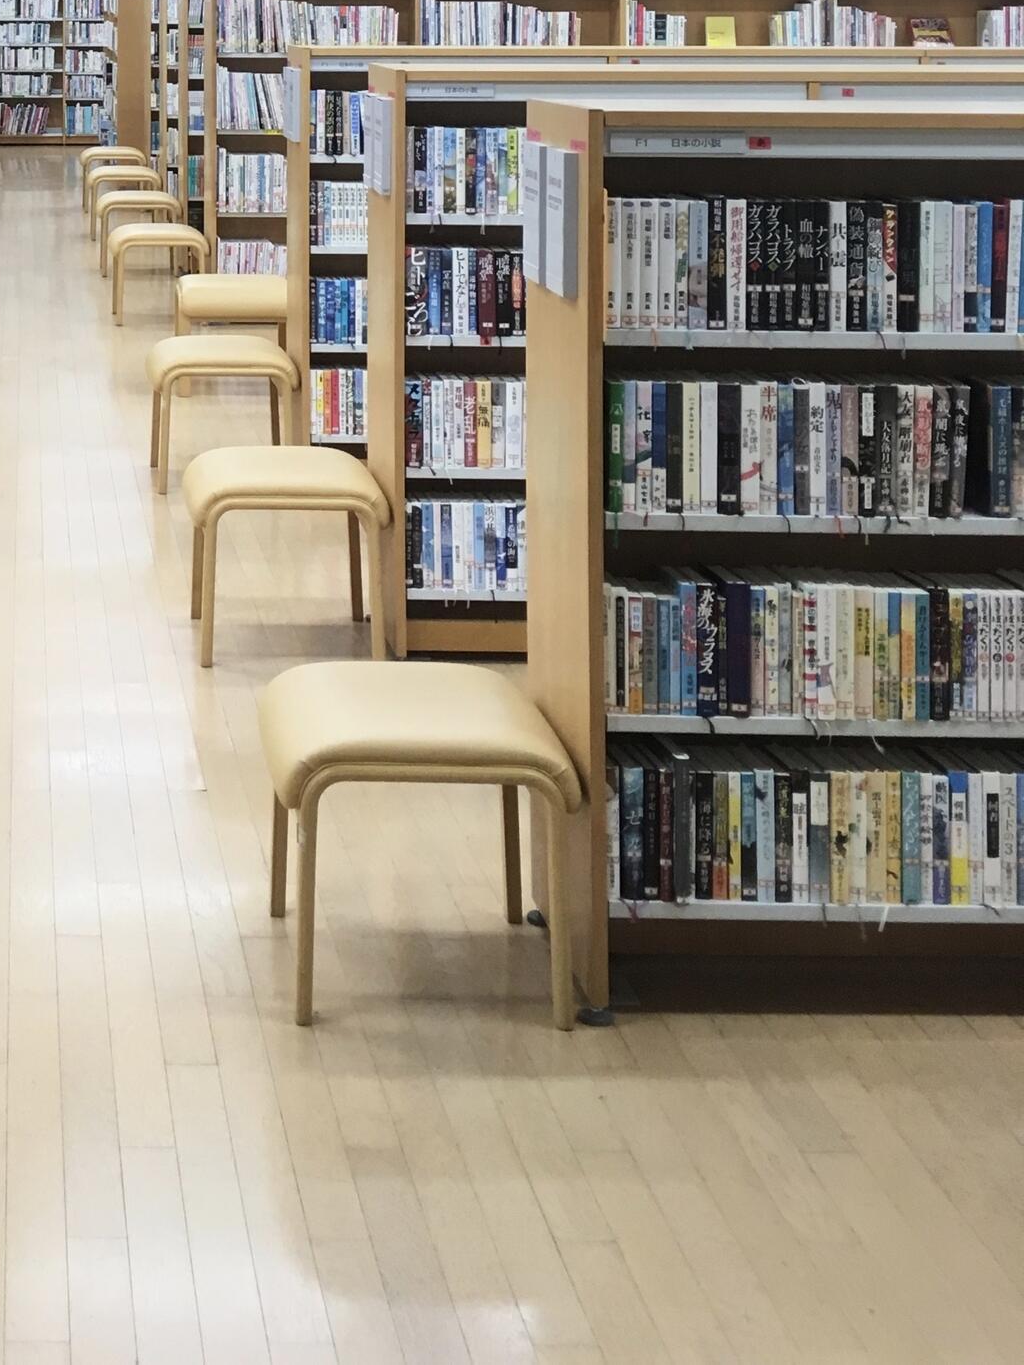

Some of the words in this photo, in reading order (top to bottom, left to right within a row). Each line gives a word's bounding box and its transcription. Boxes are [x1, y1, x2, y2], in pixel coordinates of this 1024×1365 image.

[671, 138, 721, 148] 日本の小説
[783, 223, 796, 272] トラップ
[455, 249, 467, 305] ヒトでなし
[478, 405, 490, 429] 無痛
[760, 385, 777, 423] 半席
[810, 405, 824, 433] 約定
